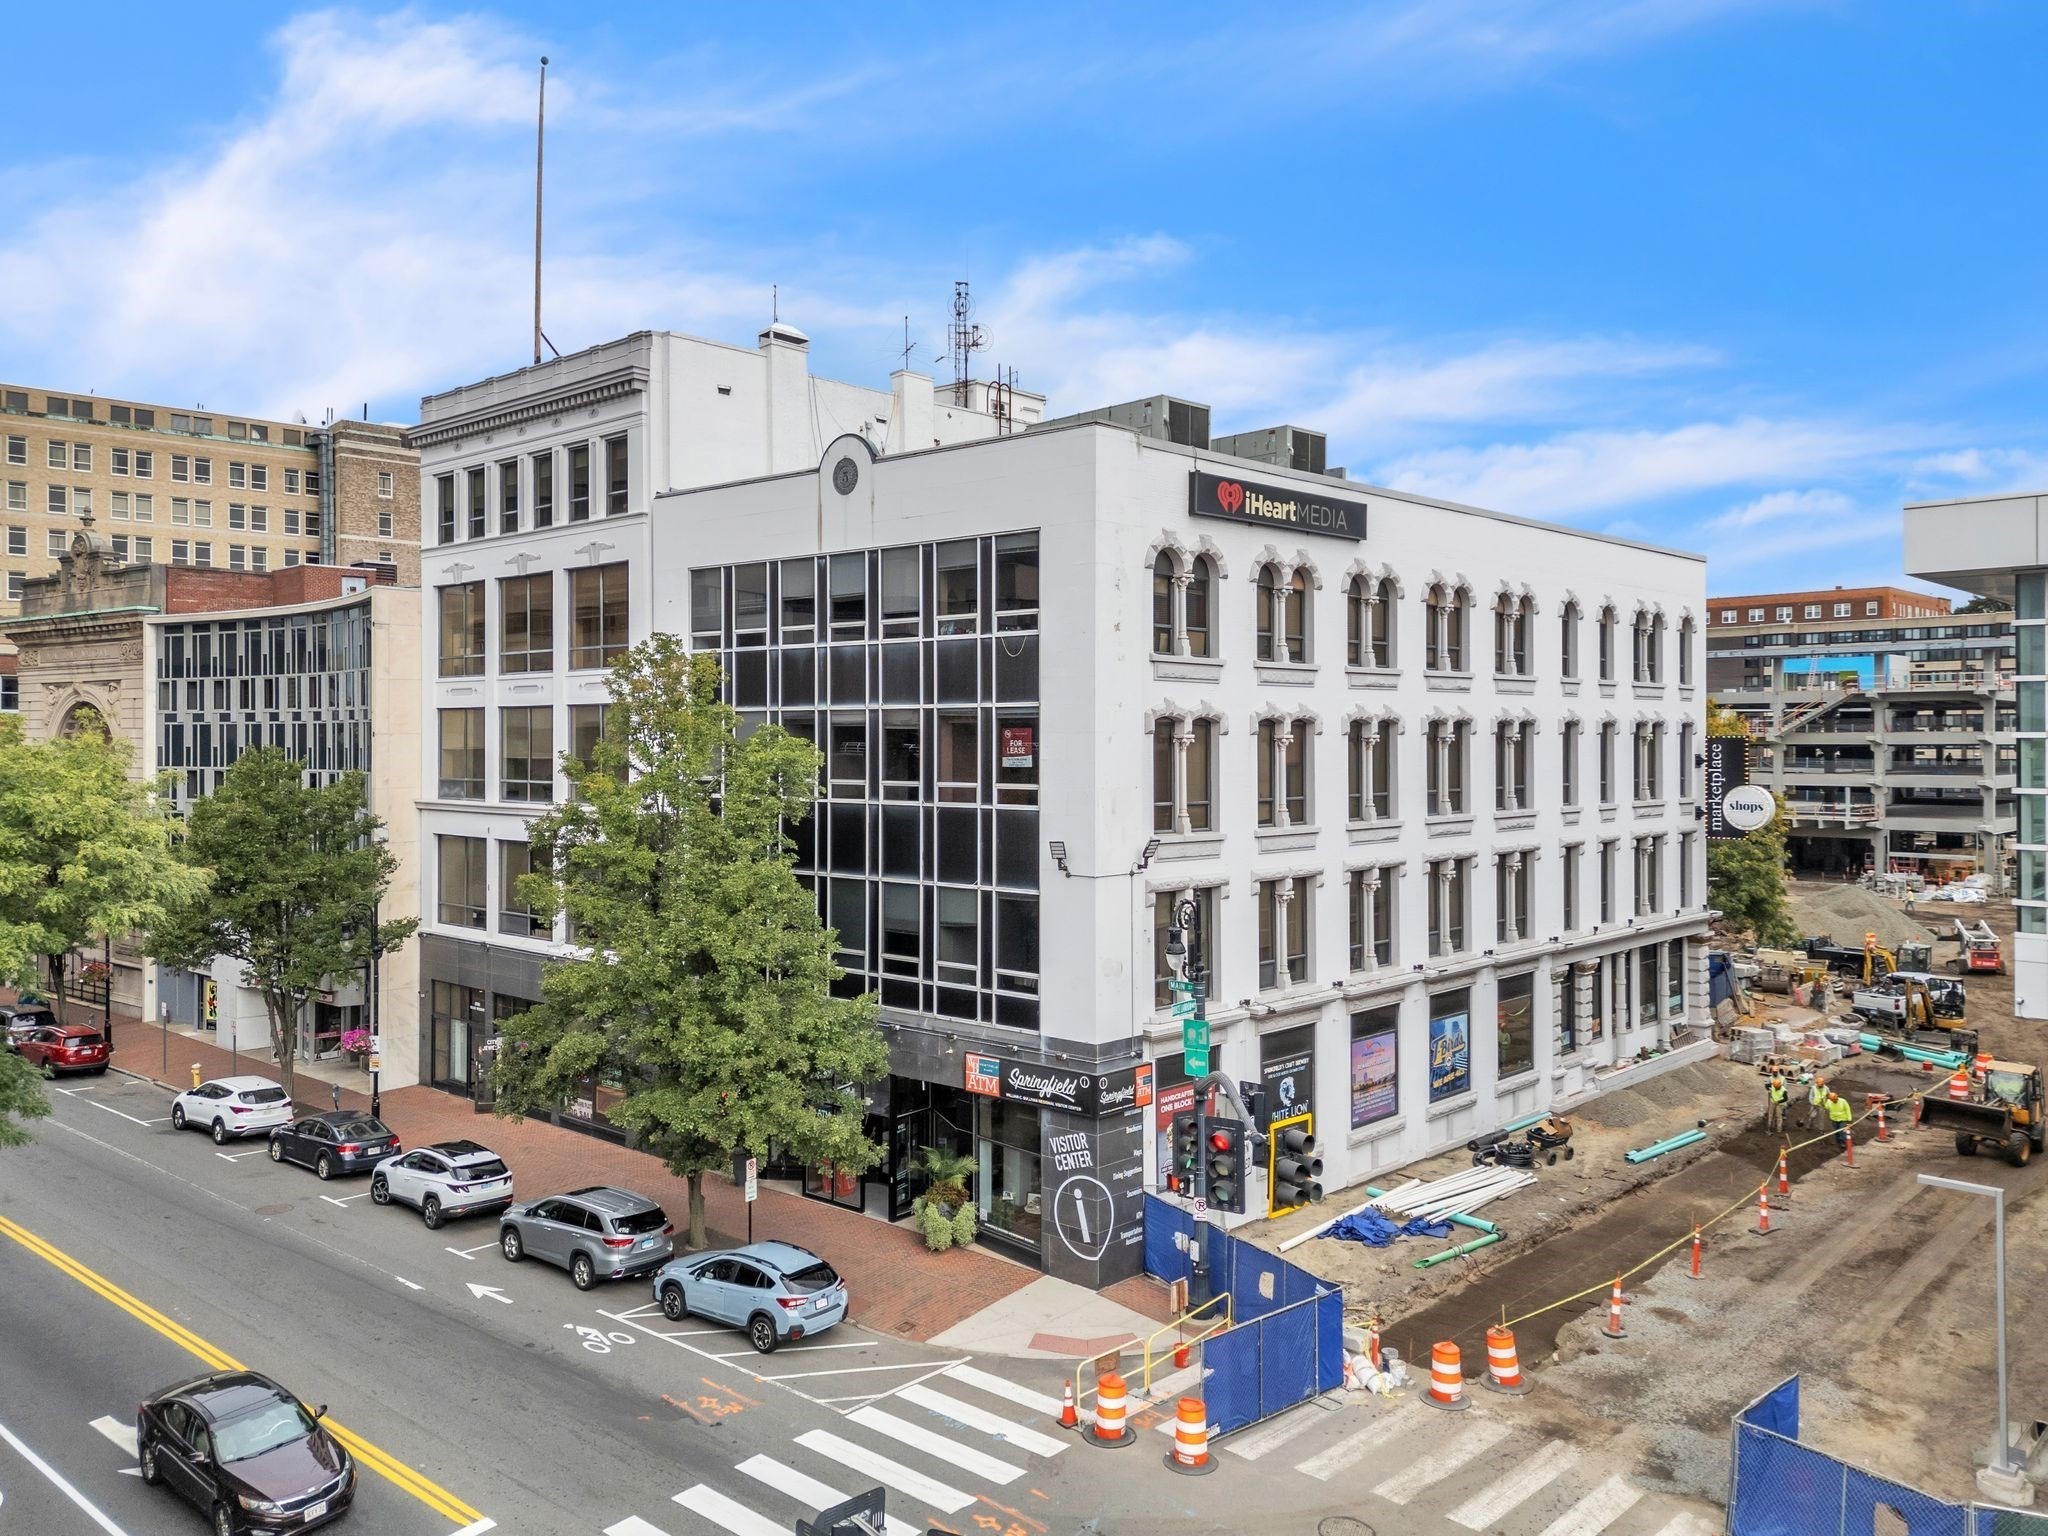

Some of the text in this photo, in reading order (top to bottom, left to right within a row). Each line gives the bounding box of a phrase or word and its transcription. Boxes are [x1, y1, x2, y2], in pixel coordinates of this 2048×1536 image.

[1006, 746, 1026, 754] LEASE
[1009, 739, 1023, 747] FOR
[1708, 743, 1726, 831] marketplace
[1729, 800, 1764, 813] shops
[1170, 981, 1186, 991] MAIN
[968, 1074, 999, 1094] ATM
[1007, 1067, 1078, 1099] Springfield
[1099, 1084, 1135, 1104] Springfield
[1136, 1086, 1152, 1098] ATM
[1160, 1088, 1194, 1104] HANDCRAFTE
[1068, 1104, 1082, 1112] CENTER
[1161, 1104, 1174, 1113] ONE
[1173, 1098, 1193, 1111] BLOCK
[1290, 1103, 1308, 1117] LION
[1049, 1132, 1089, 1154] VISITOR
[1054, 1150, 1094, 1171] CENTER
